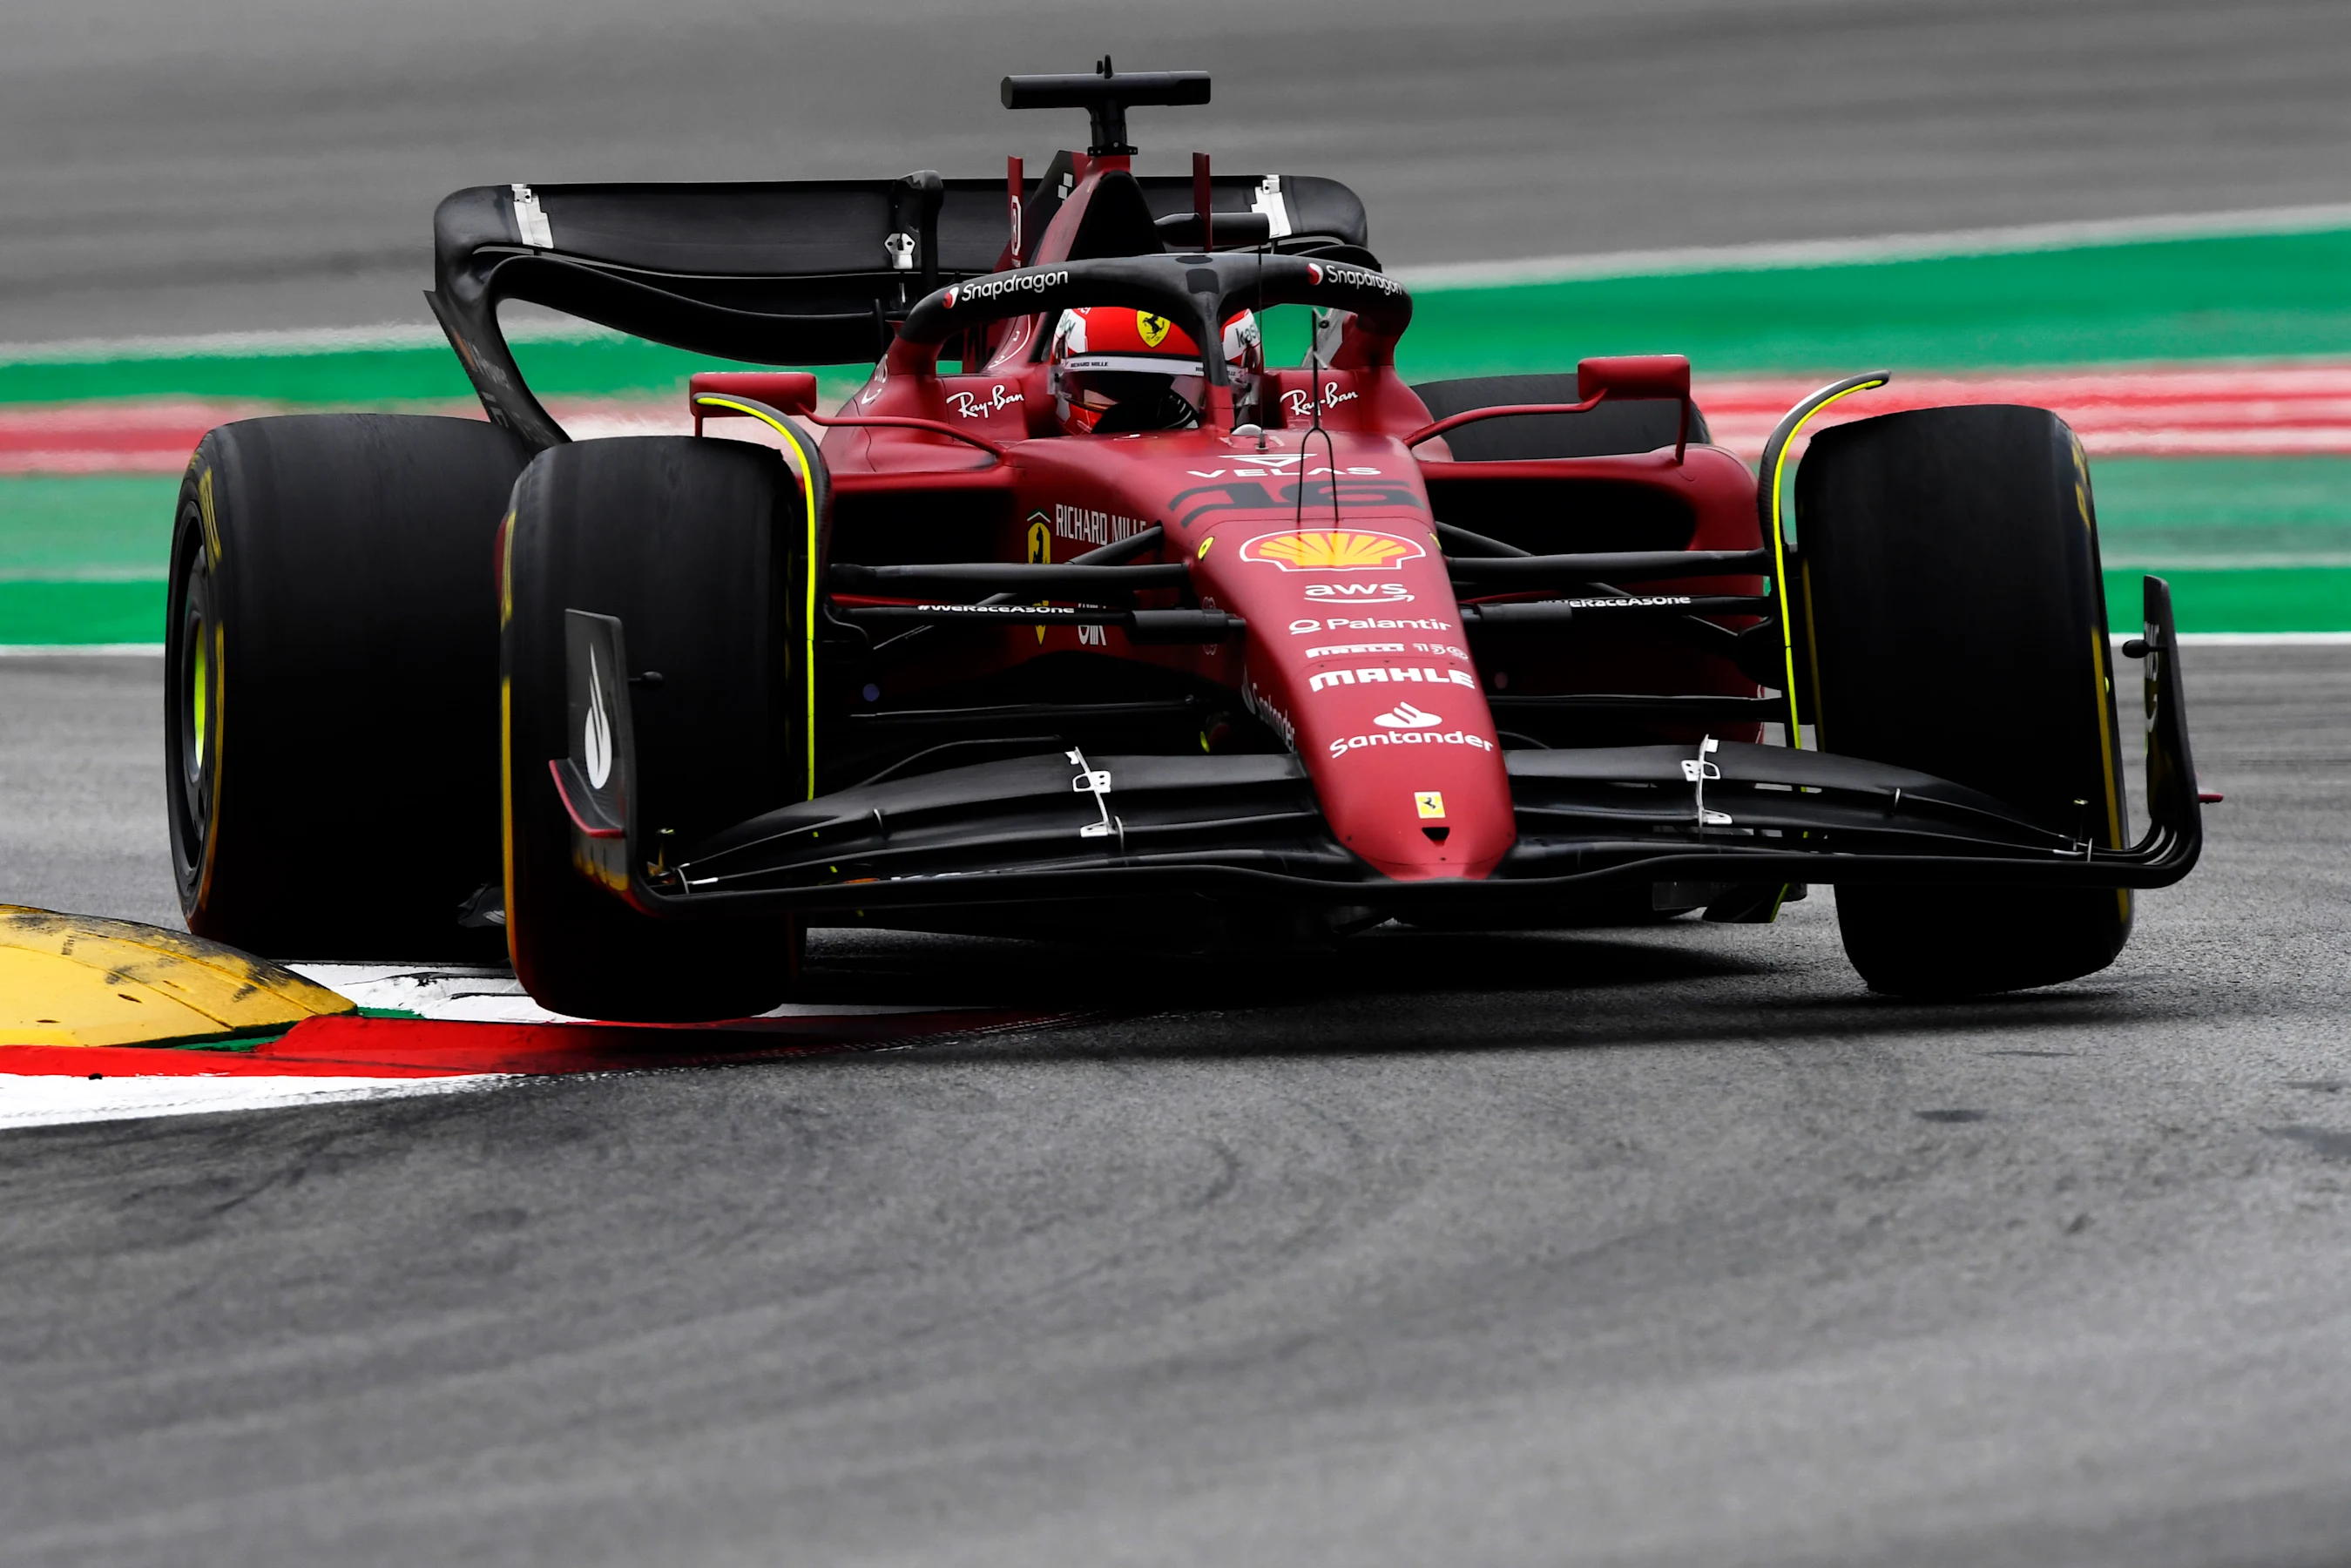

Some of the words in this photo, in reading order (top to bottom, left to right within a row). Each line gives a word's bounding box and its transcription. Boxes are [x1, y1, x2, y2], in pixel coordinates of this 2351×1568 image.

[961, 271, 1068, 301] Snapdragon
[1326, 265, 1402, 295] Snapdragon
[946, 384, 1024, 418] Ray-Ban
[1280, 382, 1358, 416] Ray-Ban
[1187, 467, 1382, 478] VELAS
[1167, 480, 1425, 528] 16
[1056, 504, 1108, 546] RICHARD
[1305, 584, 1408, 597] aws
[1327, 618, 1452, 631] Palantir
[1308, 667, 1476, 693] MAHLE
[1329, 731, 1494, 759] Santander
